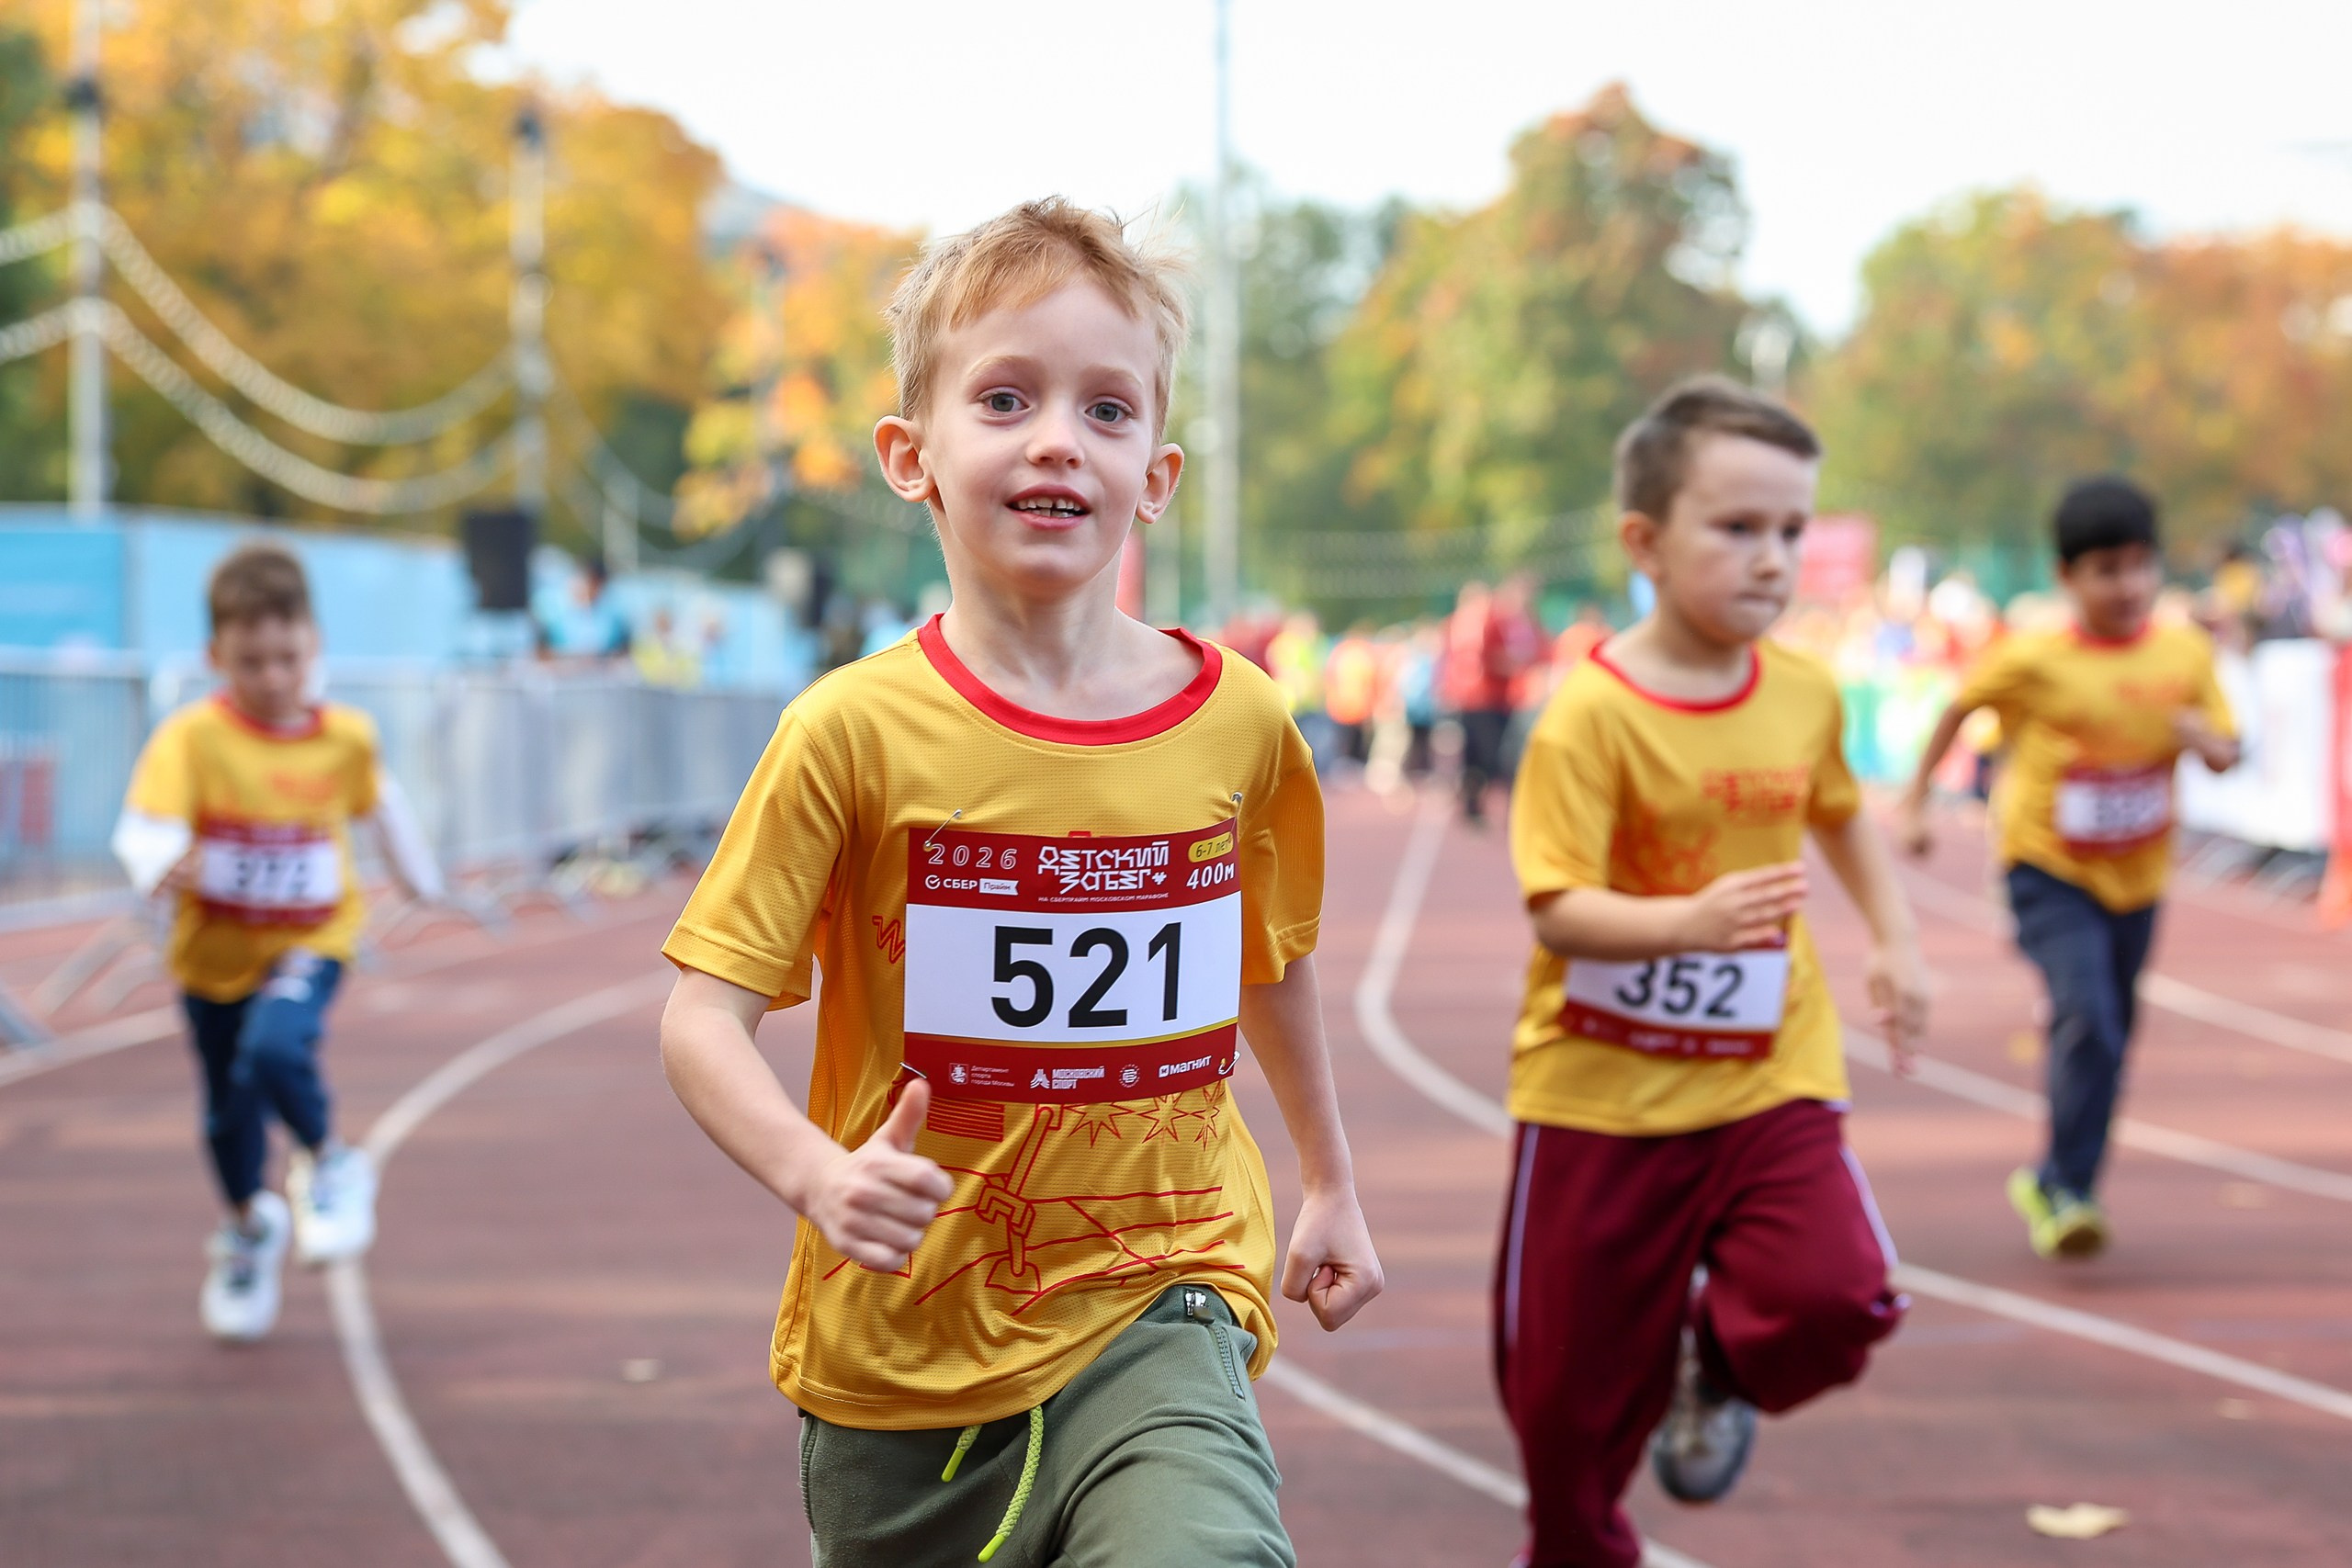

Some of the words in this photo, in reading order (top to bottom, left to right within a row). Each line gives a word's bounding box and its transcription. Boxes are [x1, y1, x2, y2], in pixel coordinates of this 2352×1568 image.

[927, 843, 1018, 870] 2026
[1037, 840, 1170, 875] ДЕТСКИЙ
[1195, 841, 1214, 858] 6-7
[943, 878, 978, 890] СБЕР
[983, 882, 1012, 891] Прайм
[1059, 869, 1152, 895] ЗАБЕГ
[990, 921, 1182, 1028] 521
[1614, 958, 1744, 1019] 352
